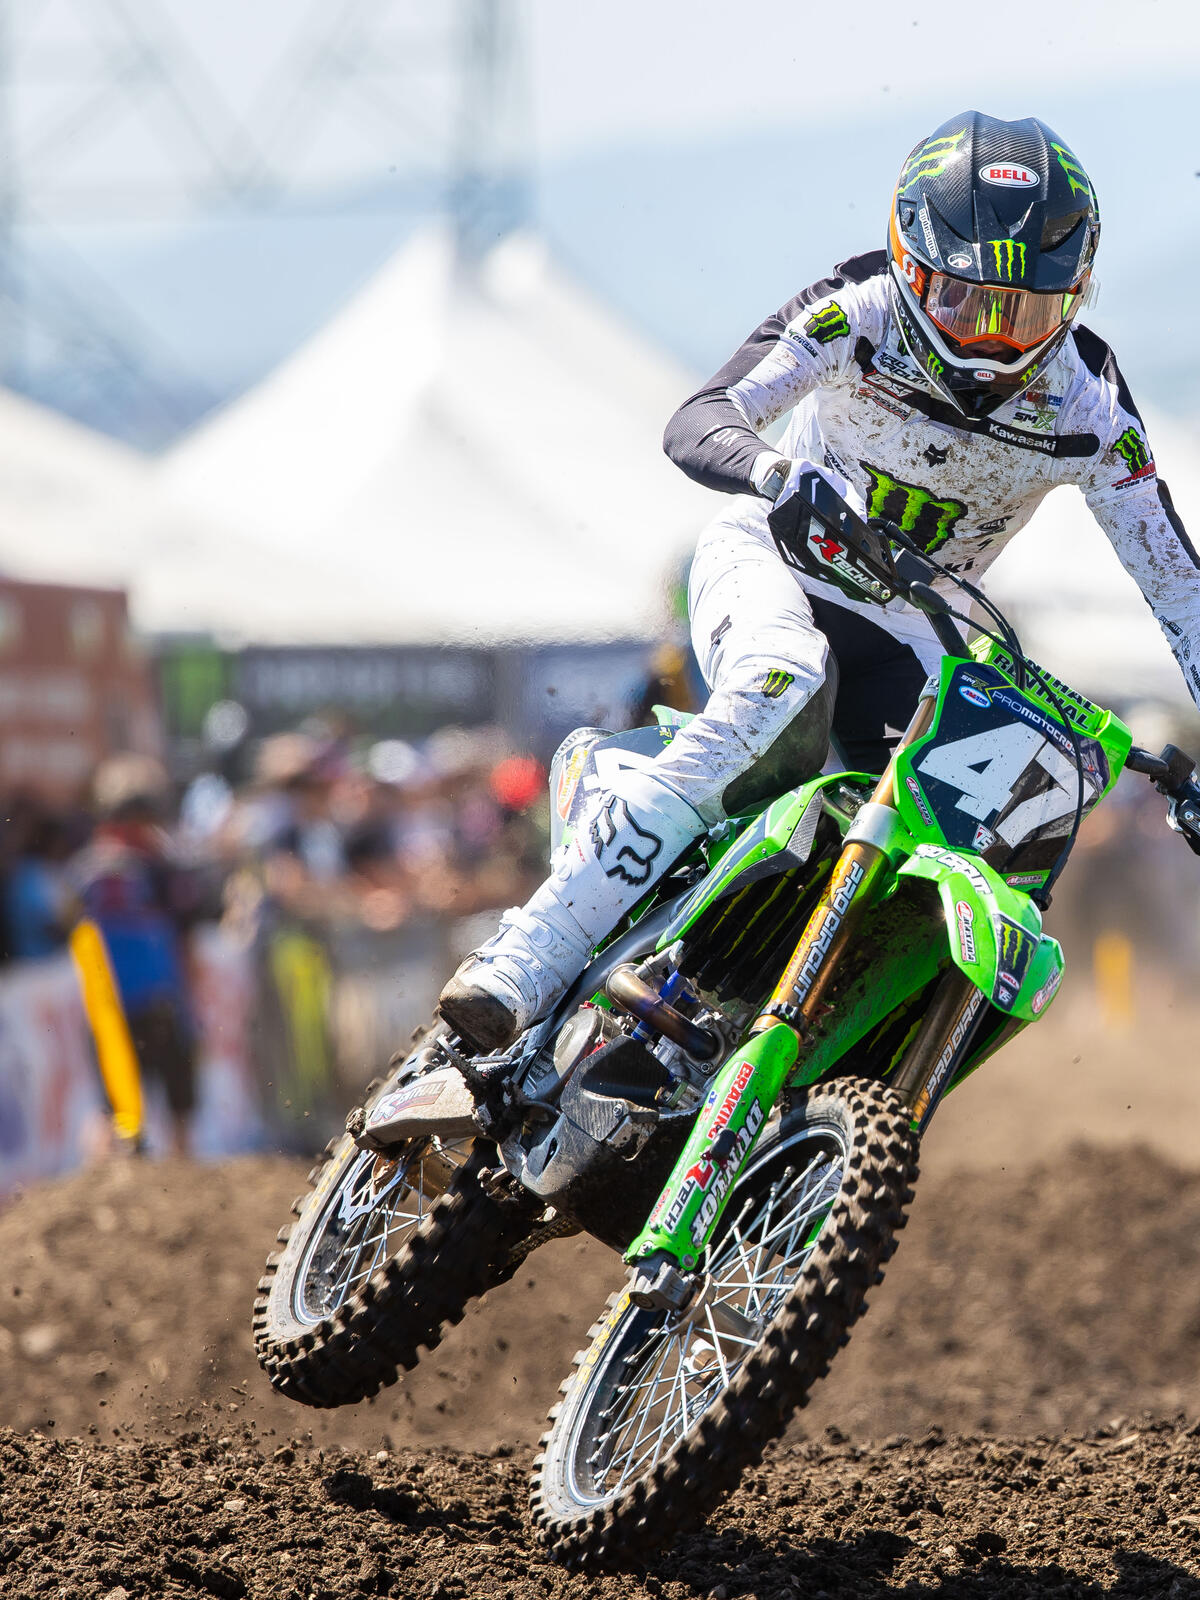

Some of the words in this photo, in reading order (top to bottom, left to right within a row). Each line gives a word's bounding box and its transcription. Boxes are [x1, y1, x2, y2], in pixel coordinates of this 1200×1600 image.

[989, 168, 1031, 183] BELL
[976, 371, 993, 379] BELL
[825, 444, 853, 482] UNLOP
[988, 423, 1056, 452] Kawasaki
[992, 691, 1083, 757] PROMOTOCROS
[917, 721, 1095, 849] 47
[831, 860, 865, 917] PRO
[792, 909, 842, 1004] CIRCUIT
[1002, 973, 1018, 987] BELL
[925, 1044, 953, 1099] PRO
[708, 1061, 755, 1140] BRAKING
[690, 1097, 764, 1247] DUNLOP
